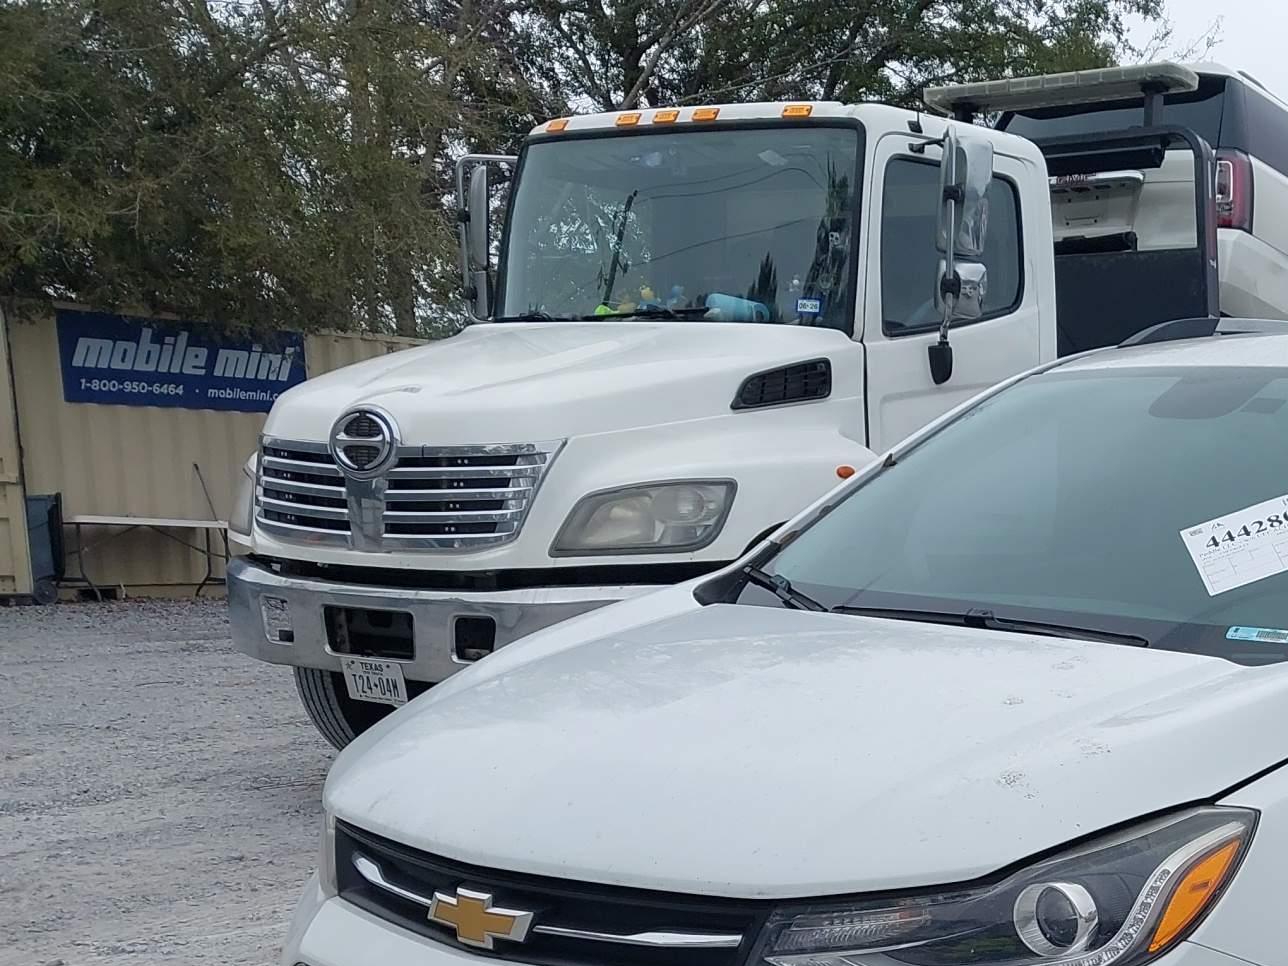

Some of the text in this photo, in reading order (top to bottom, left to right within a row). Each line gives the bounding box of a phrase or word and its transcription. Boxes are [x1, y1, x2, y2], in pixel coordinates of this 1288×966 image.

[72, 328, 292, 381] mobile mini
[80, 378, 184, 395] 1-800-950-6464
[360, 662, 384, 673] TEXAS
